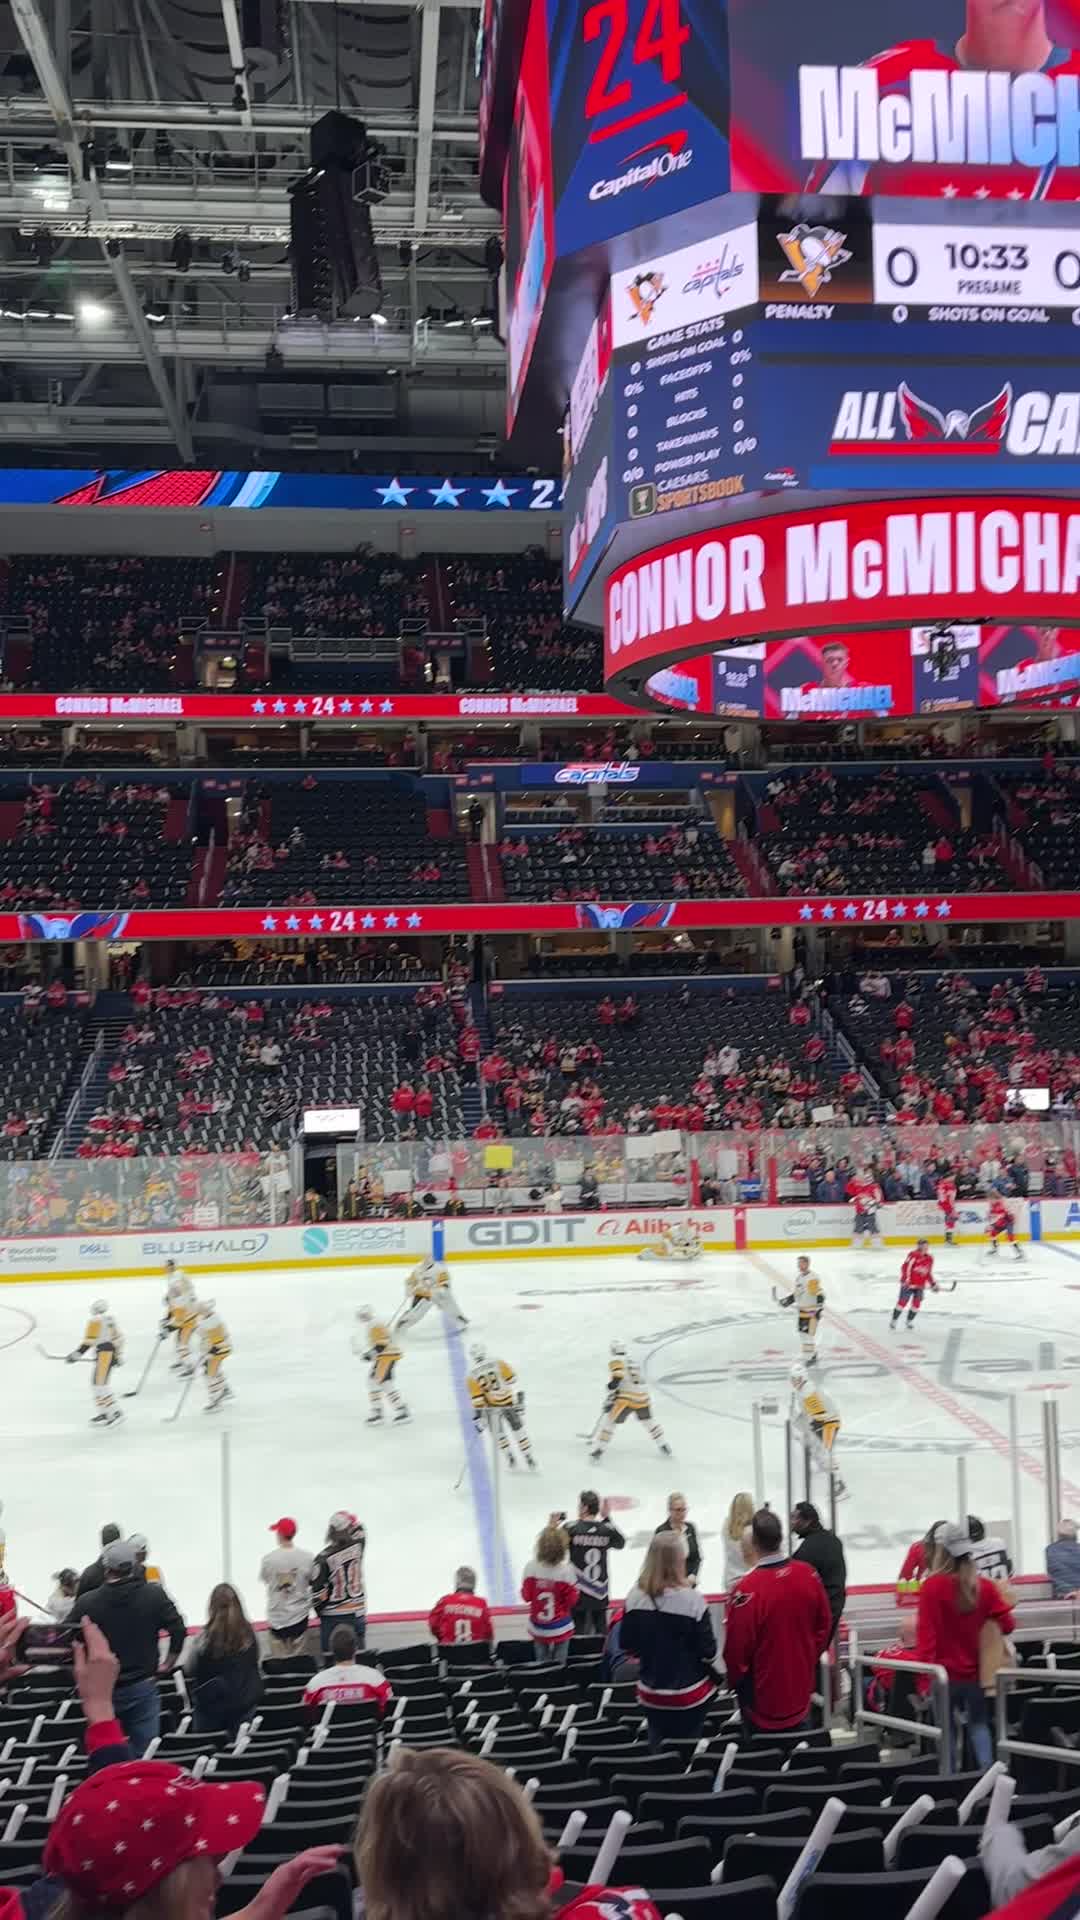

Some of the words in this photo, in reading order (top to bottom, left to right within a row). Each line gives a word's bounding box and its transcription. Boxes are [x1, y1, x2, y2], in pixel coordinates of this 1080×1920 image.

[584, 0, 690, 119] 24
[887, 246, 918, 288] 0
[945, 243, 1030, 271] 10:33
[957, 279, 1023, 296] PREGAME
[765, 304, 835, 320] PENALTY
[928, 306, 979, 322] SHOTS
[980, 306, 1005, 322] ON
[1006, 307, 1050, 323] GOAL
[647, 328, 684, 350] GAME
[685, 316, 726, 340] STATS
[646, 350, 679, 370] SHOTS
[679, 345, 697, 359] ON
[697, 335, 727, 354] GOAL
[659, 361, 713, 386] FACEOFFS
[674, 387, 699, 403] HITS
[666, 407, 708, 428] BLOCKS
[832, 391, 897, 440] ALL
[656, 426, 719, 452] TAKEAWAYS
[654, 454, 695, 474] POWER
[694, 447, 721, 465] PLAY
[657, 469, 709, 492] CAESARS
[657, 474, 744, 512] SPORTSBOOK
[529, 479, 563, 509] 2
[609, 534, 766, 655] CONNOR
[55, 697, 108, 713] CONNOR
[312, 697, 335, 715] 24
[459, 697, 508, 713] CONNOR
[554, 761, 640, 785] capitals
[330, 910, 356, 932] 24
[863, 899, 888, 921] 24
[468, 1218, 586, 1246] GDIT
[625, 1218, 715, 1235] Alibba
[584, 1548, 602, 1582] 8
[537, 1592, 555, 1621] 3
